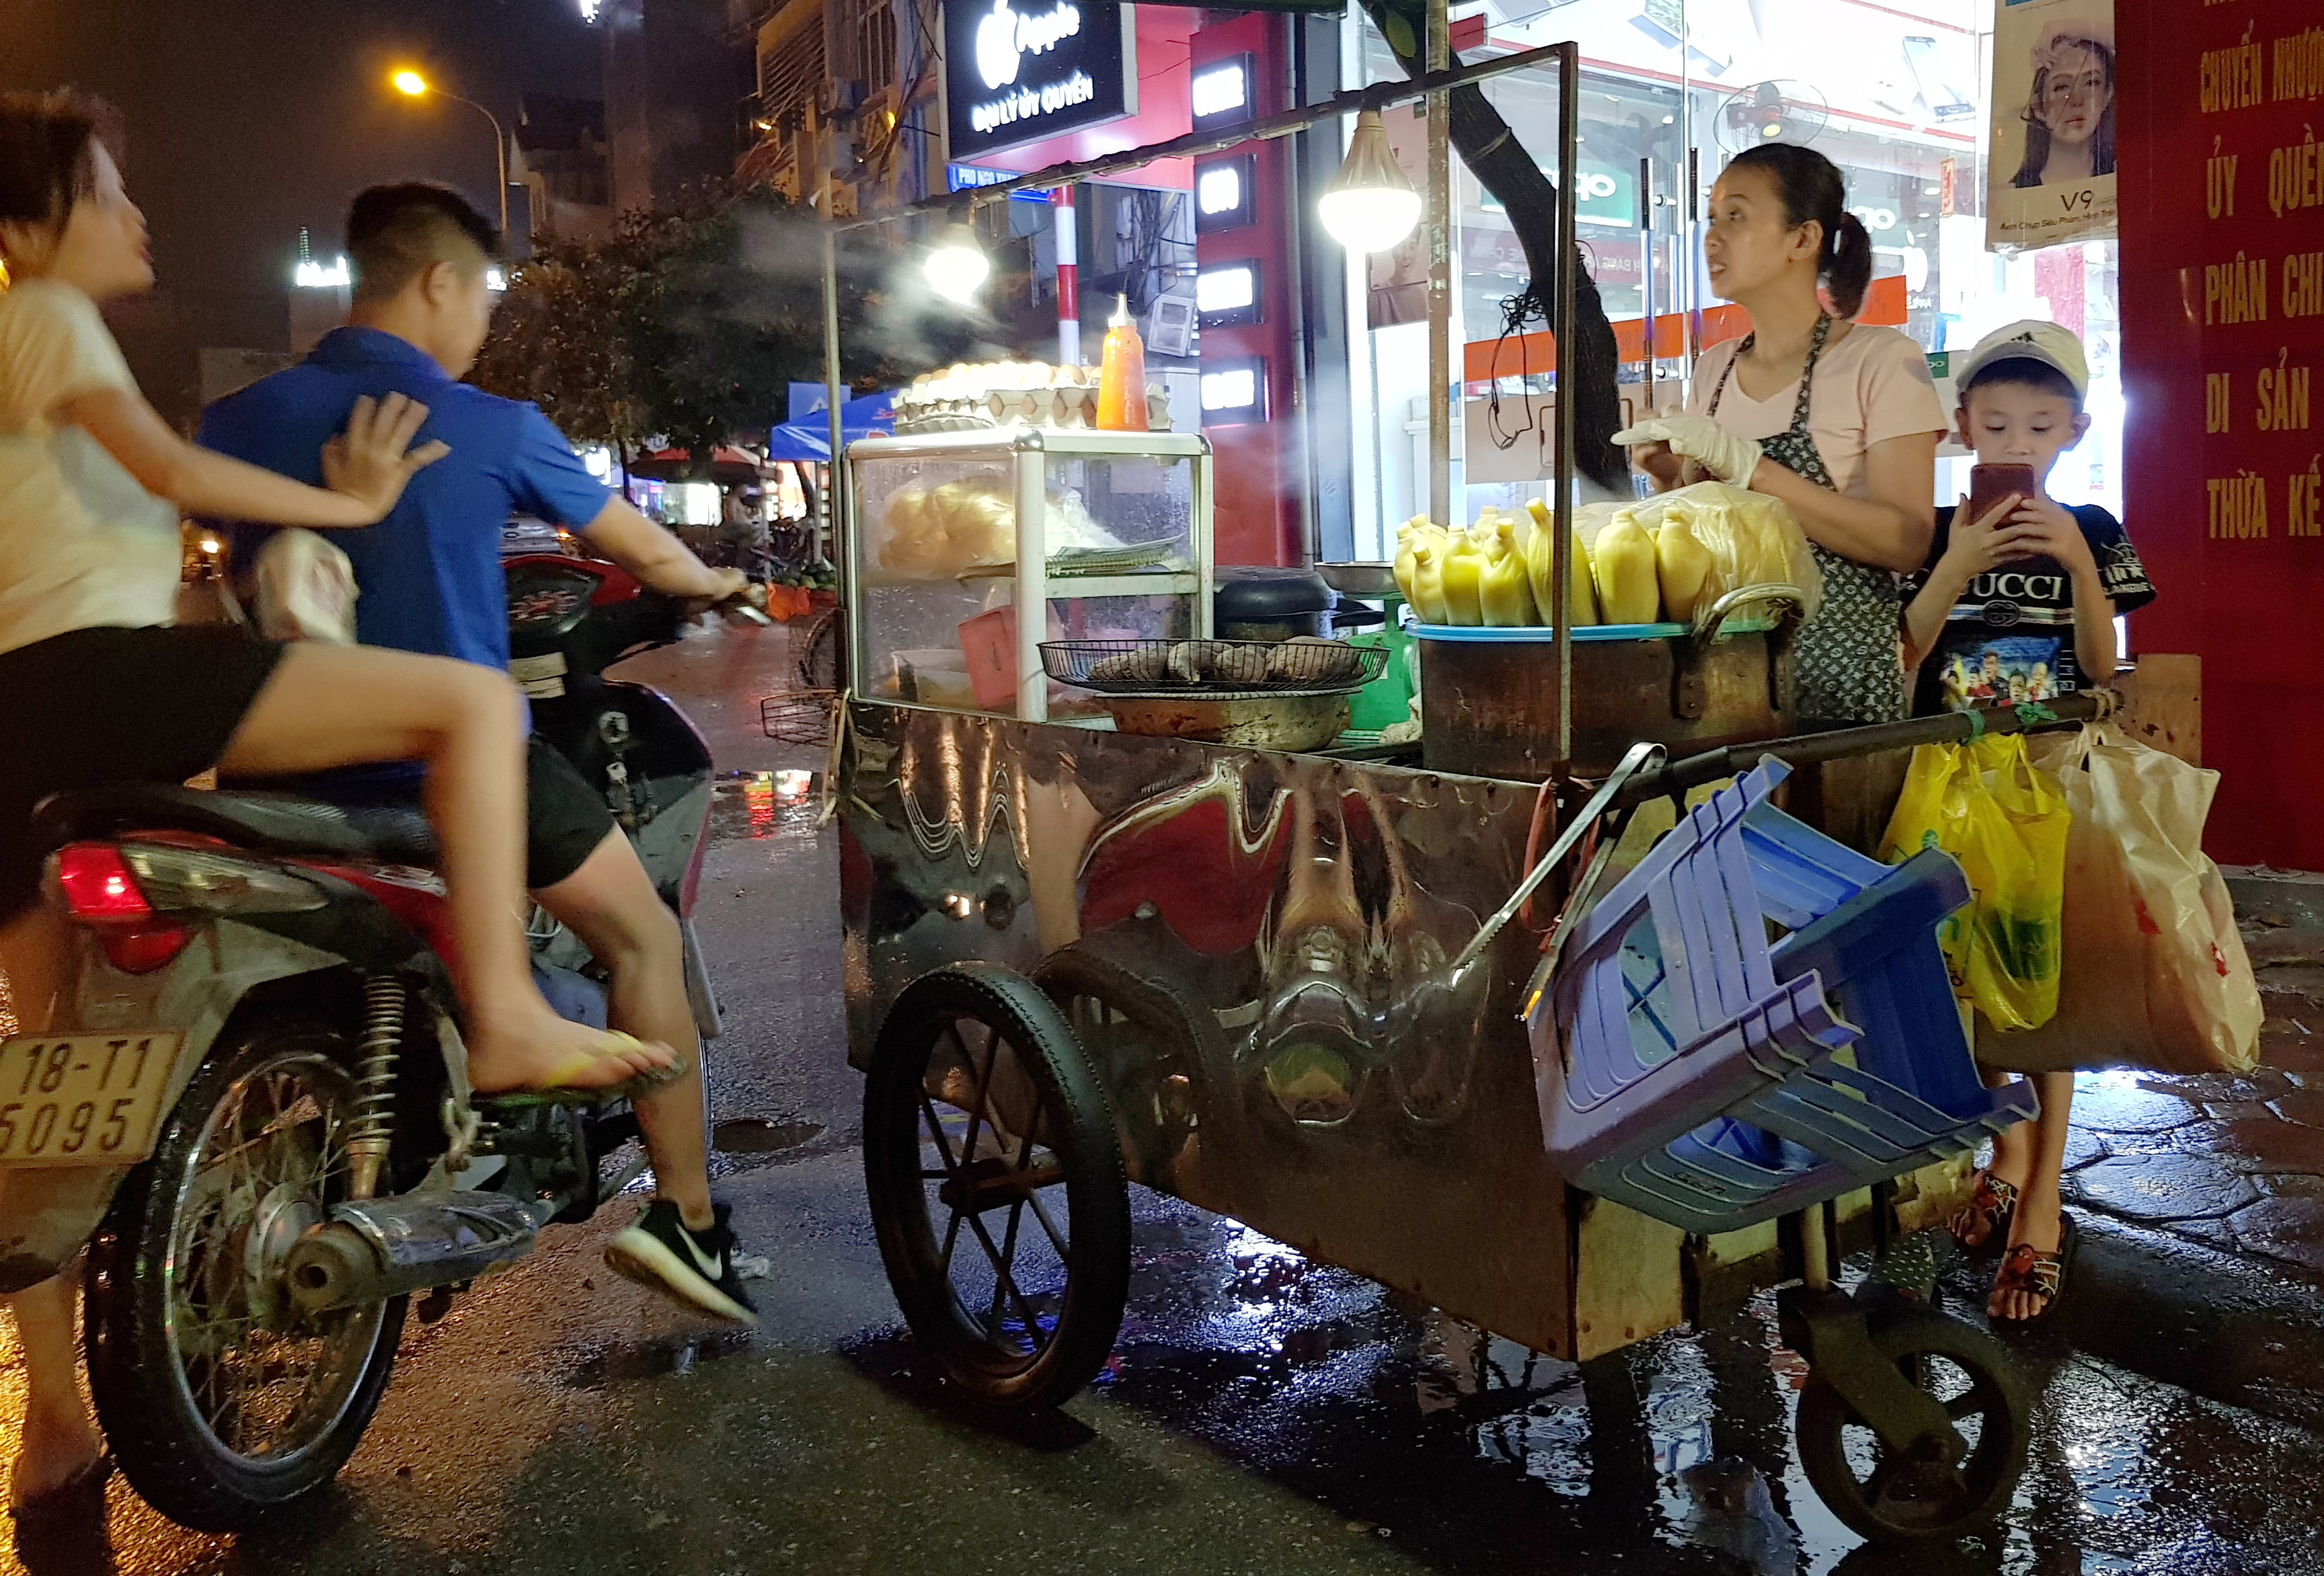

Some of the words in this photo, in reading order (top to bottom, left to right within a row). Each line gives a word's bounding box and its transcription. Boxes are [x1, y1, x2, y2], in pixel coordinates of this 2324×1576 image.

[1016, 1, 1080, 55] Apple
[2060, 190, 2092, 212] V9
[2206, 250, 2267, 325] PHÂN
[2283, 251, 2324, 318] CHI
[2206, 372, 2230, 434] DI
[2256, 346, 2309, 431] SẢN
[2207, 468, 2268, 539] THỪA
[2288, 453, 2322, 537] KẾ
[1964, 573, 2064, 600] UCCI
[18, 1038, 152, 1095] 18-T1
[0, 1098, 134, 1156] 5095
